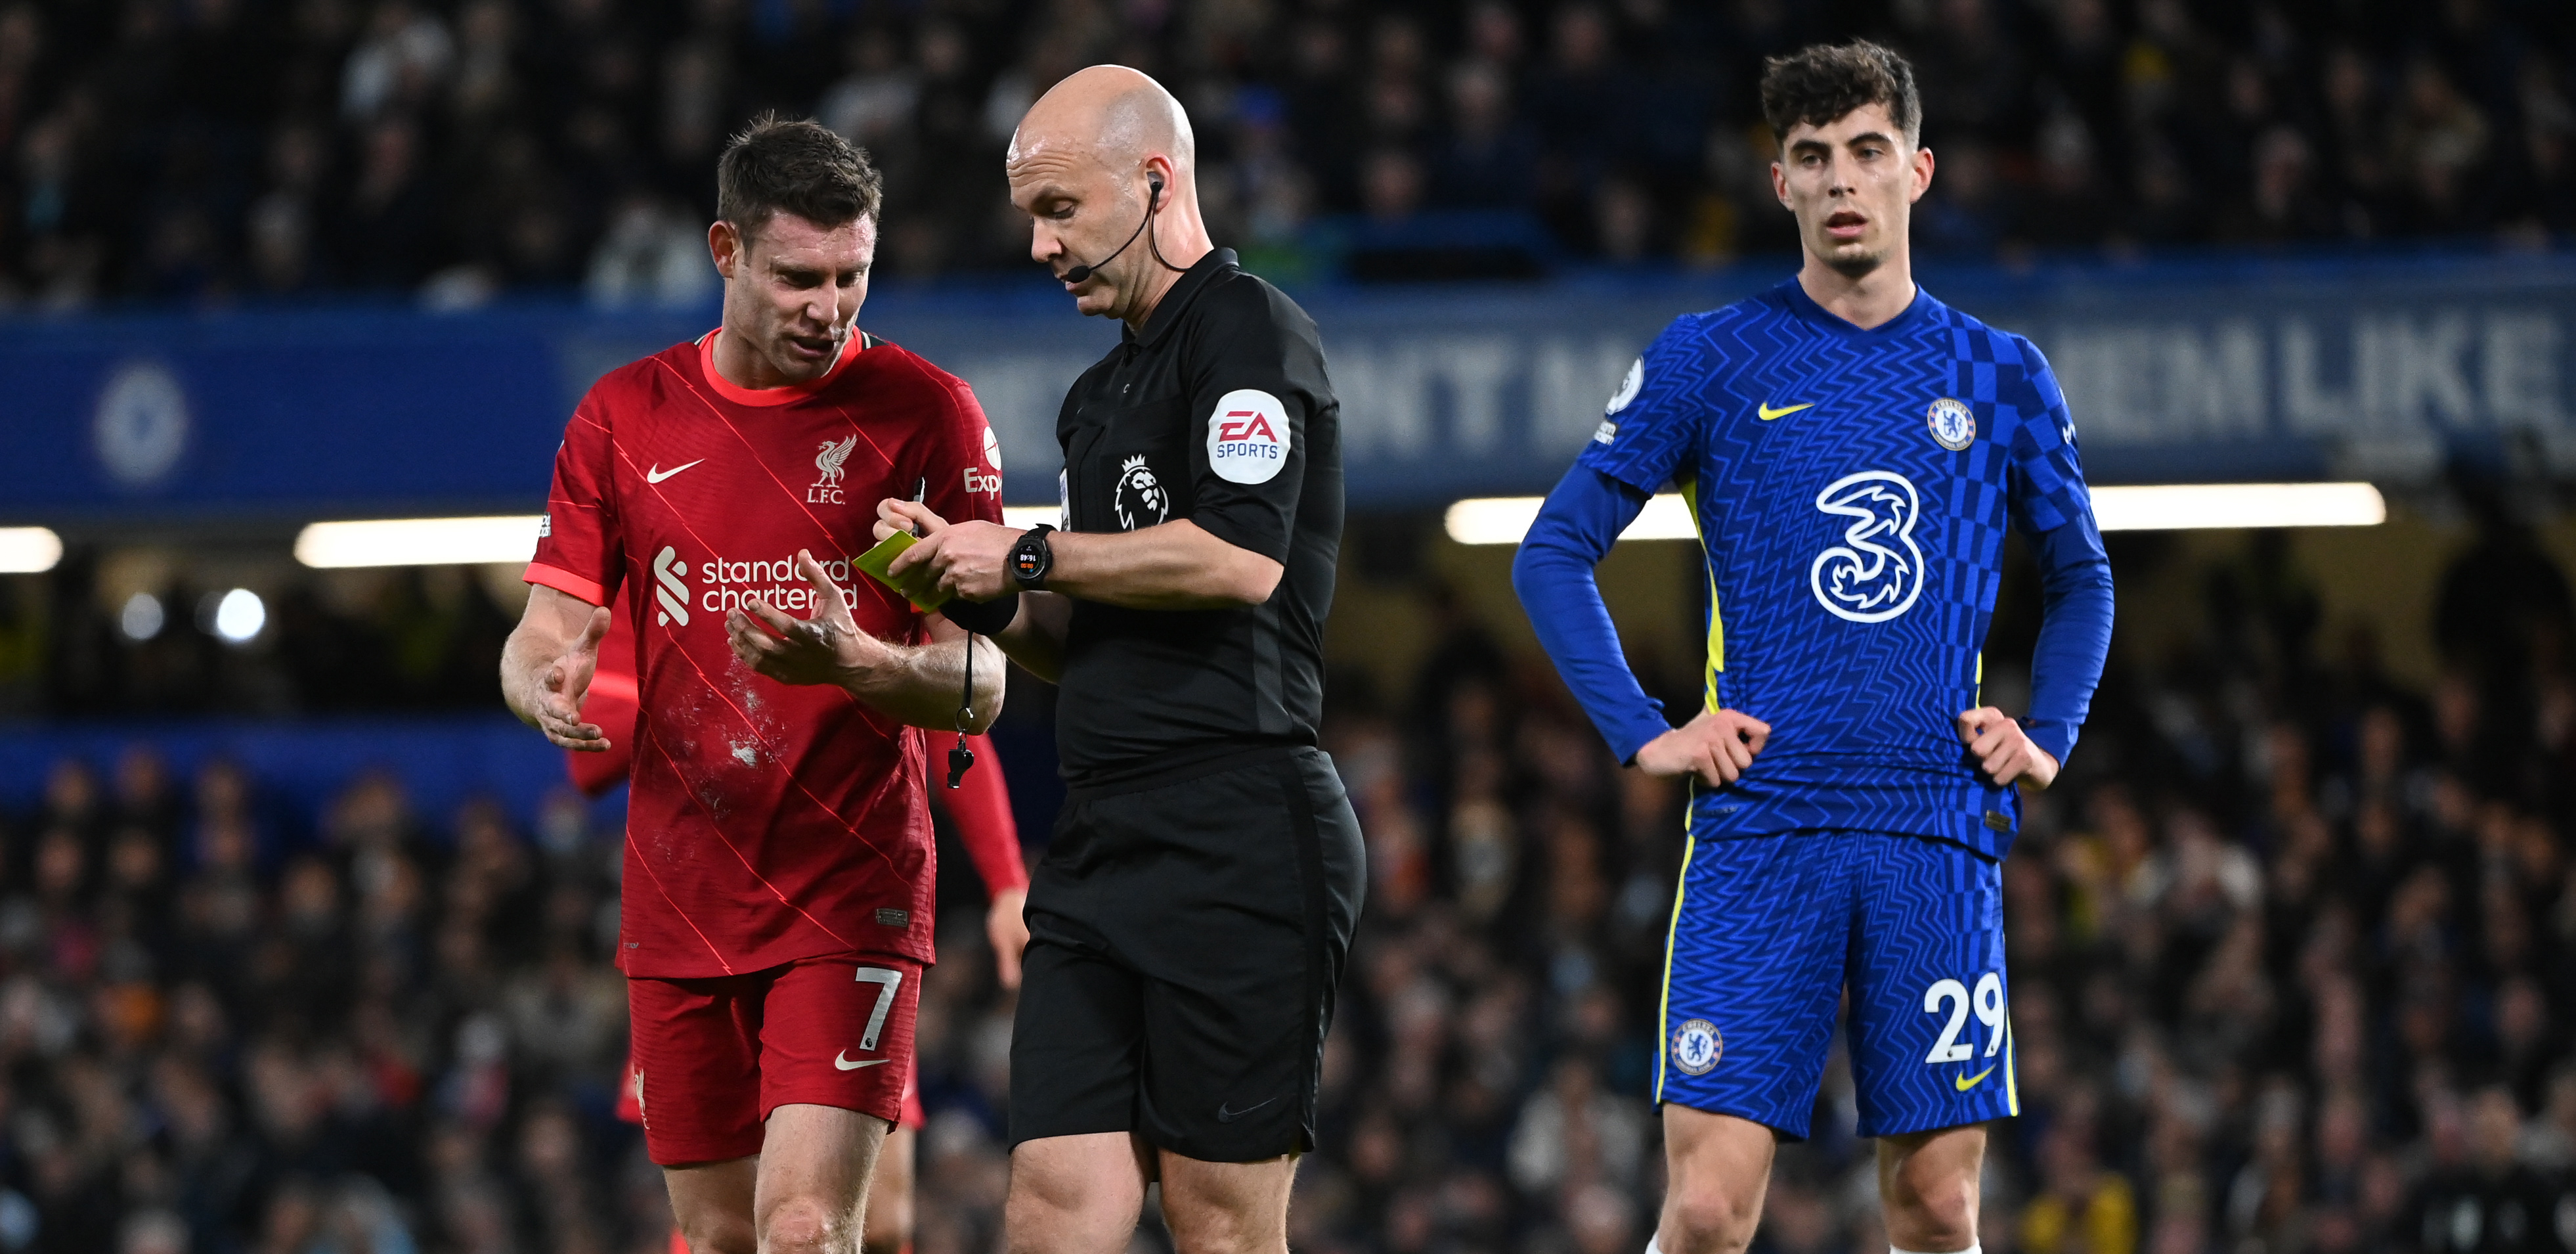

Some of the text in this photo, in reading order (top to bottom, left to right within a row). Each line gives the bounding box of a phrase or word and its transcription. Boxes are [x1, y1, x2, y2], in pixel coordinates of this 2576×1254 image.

[1219, 411, 1278, 443] EA
[1217, 443, 1278, 459] SPORTS
[807, 488, 846, 504] L.F.C.
[1810, 470, 1925, 623] 3
[702, 583, 858, 612] charterd
[855, 966, 903, 1051] 7
[1924, 972, 2005, 1064] 29
